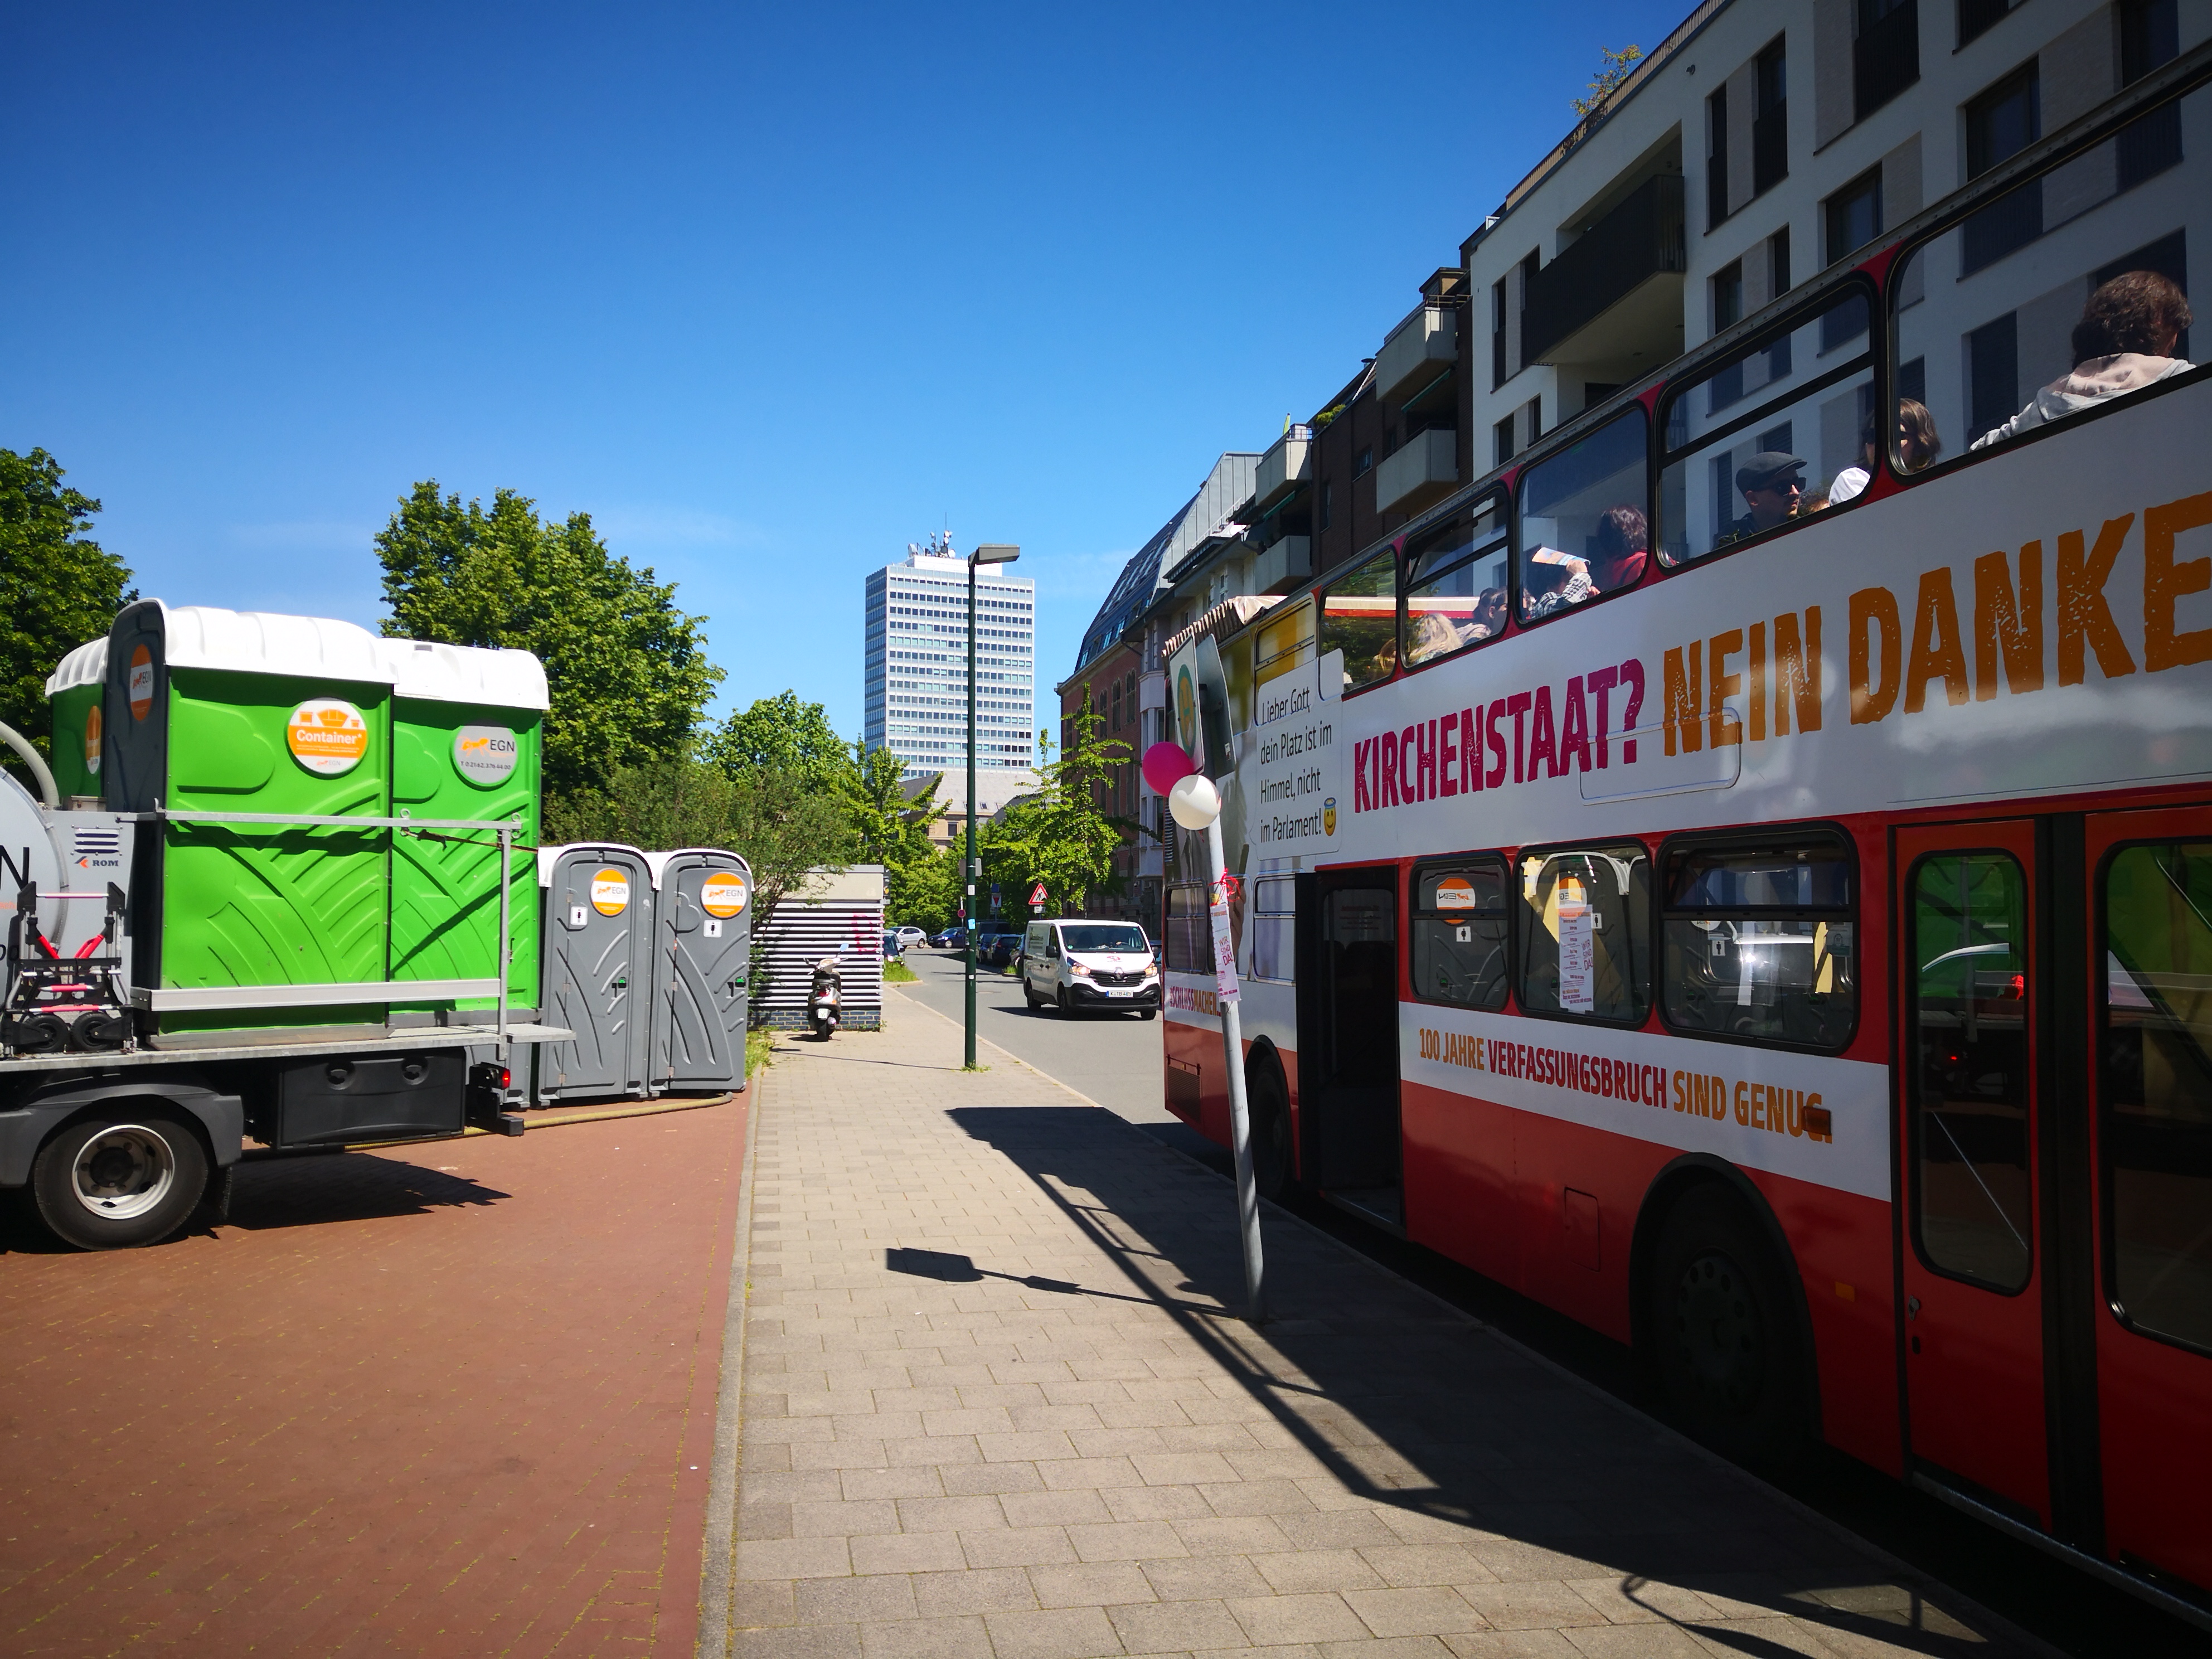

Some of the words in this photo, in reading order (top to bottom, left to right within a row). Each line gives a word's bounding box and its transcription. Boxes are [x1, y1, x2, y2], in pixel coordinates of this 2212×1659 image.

[1354, 658, 1645, 813] KIRCHENSTAAT?
[1664, 606, 1822, 756] NEIN
[1849, 490, 2212, 725] DANKE
[1262, 697, 1288, 726] Lieber
[490, 739, 515, 752] EGN
[1260, 738, 1278, 765] dein
[1280, 732, 1303, 759] Platz
[1305, 725, 1317, 752] ist
[1320, 720, 1332, 747] im
[1260, 772, 1296, 804] Himmel,
[1297, 767, 1321, 795] nicht
[1260, 819, 1270, 843] im
[1272, 808, 1321, 841] Parlament!
[612, 886, 627, 895] EGN
[1219, 936, 1229, 947] WIR
[1419, 1028, 1440, 1061] 100
[1443, 1033, 1485, 1070] JAHRE
[1488, 1039, 1667, 1108] VERFASSUNGSBRUCH
[1673, 1070, 1726, 1120] SIND
